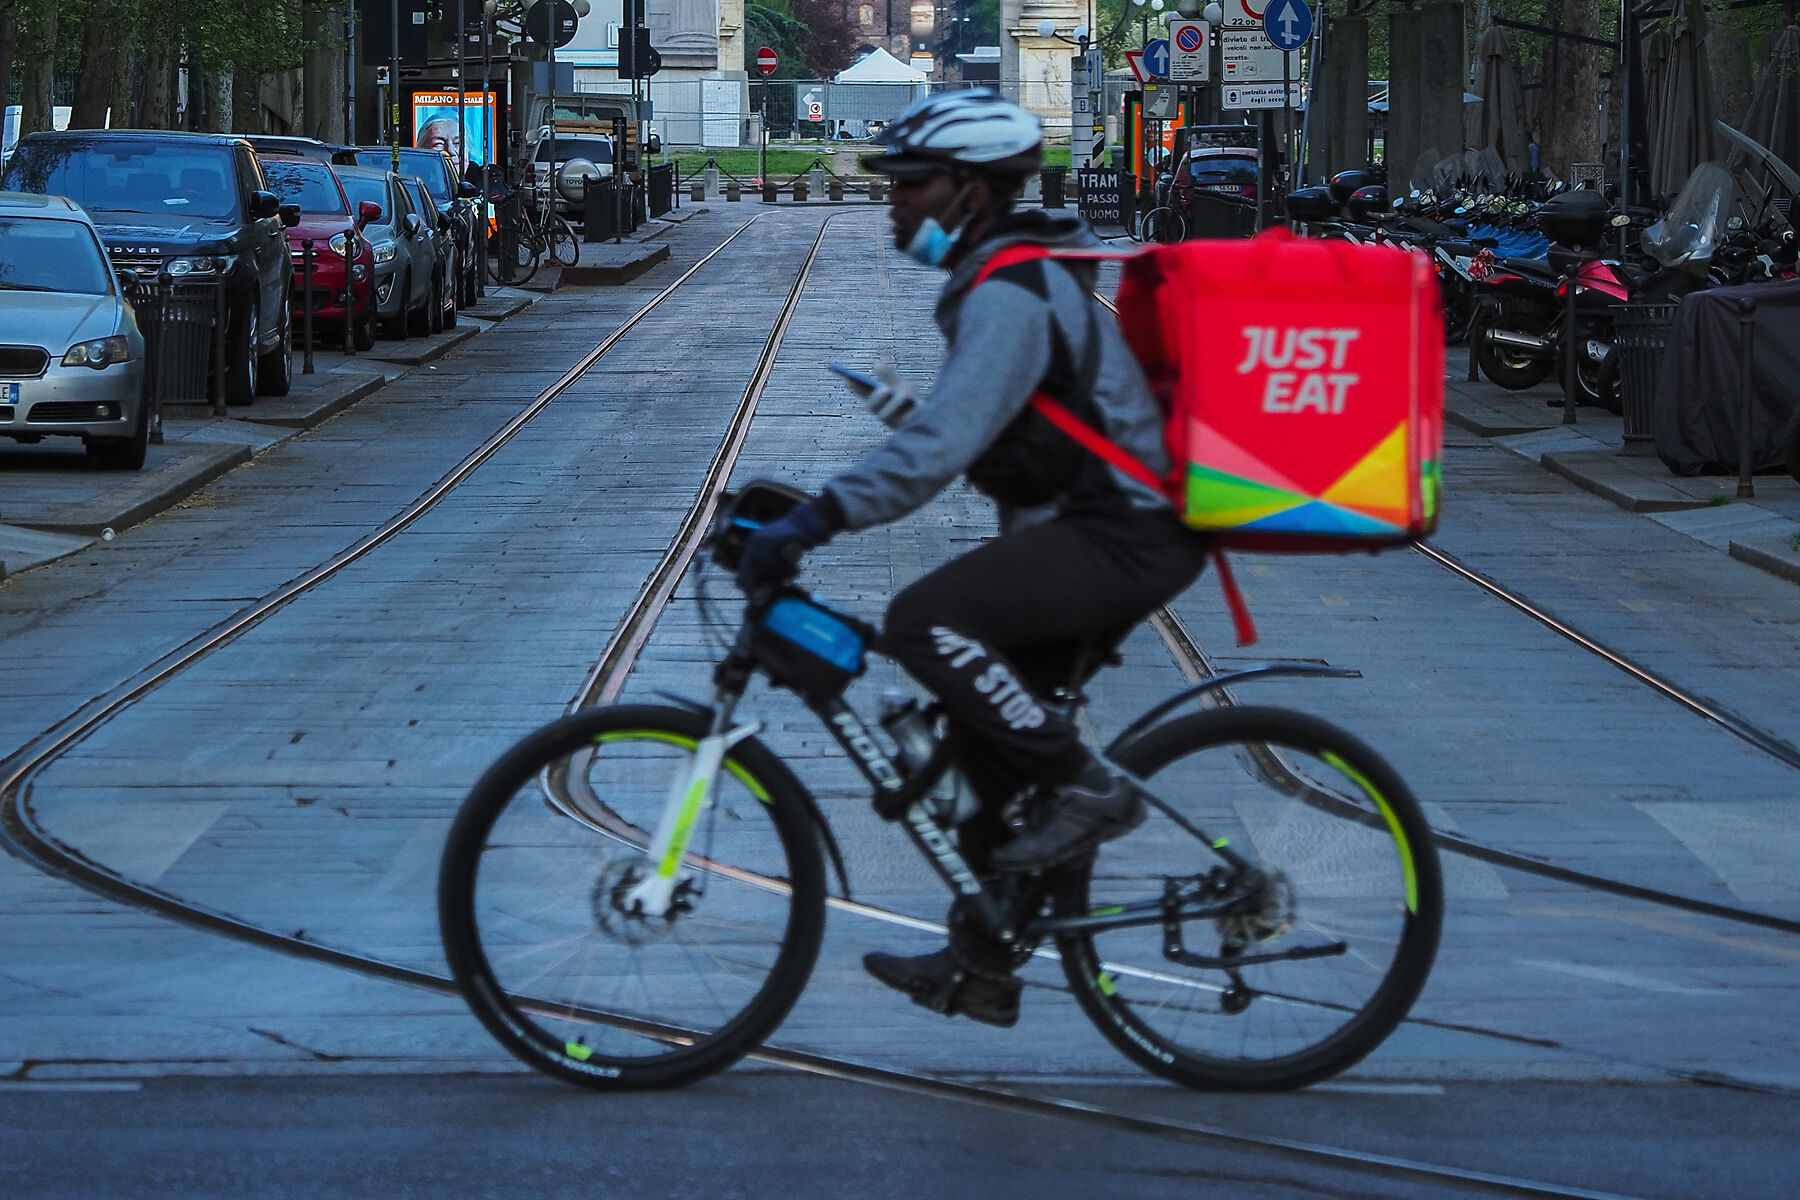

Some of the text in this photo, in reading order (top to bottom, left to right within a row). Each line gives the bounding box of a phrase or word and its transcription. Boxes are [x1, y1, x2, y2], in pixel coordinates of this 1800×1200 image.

[414, 95, 453, 103] MILANO
[1080, 173, 1118, 188] TRAM
[1087, 193, 1119, 204] PASSO
[1236, 325, 1360, 375] JUST
[1262, 371, 1360, 415] EAT
[974, 663, 1045, 730] STOP
